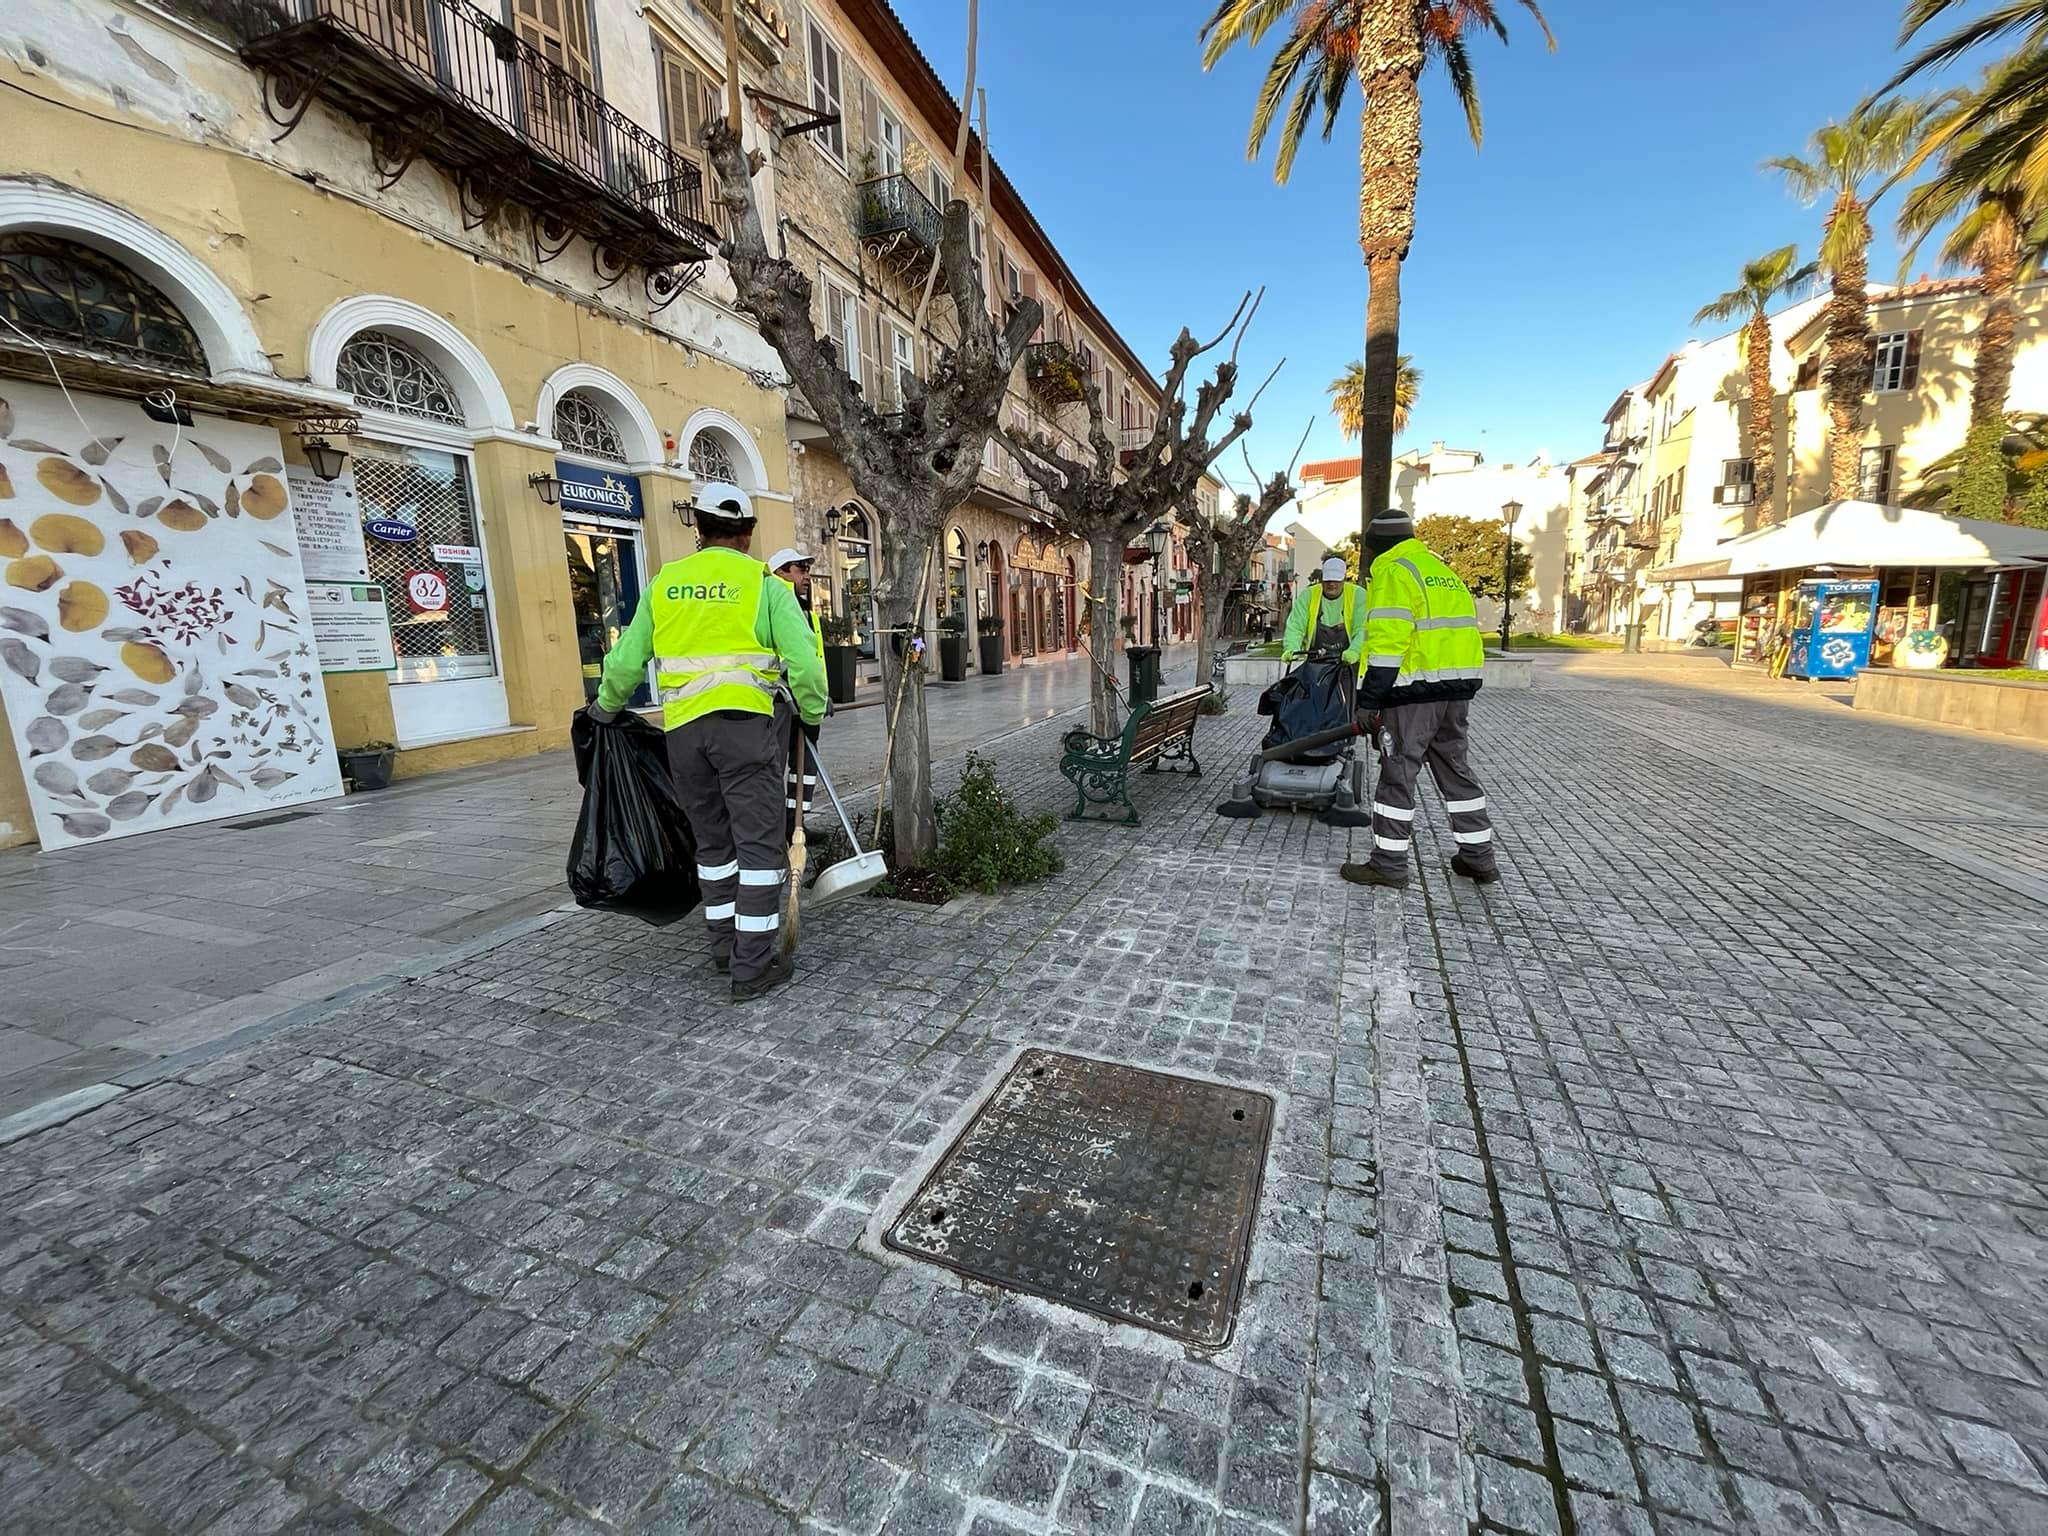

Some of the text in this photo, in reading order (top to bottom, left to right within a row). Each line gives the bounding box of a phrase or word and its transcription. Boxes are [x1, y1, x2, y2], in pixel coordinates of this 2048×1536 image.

[562, 483, 625, 505] EURONICS
[372, 522, 412, 537] Carrier
[437, 547, 471, 556] TOSHIBA
[415, 578, 441, 598] 32
[1424, 575, 1458, 588] enact
[1829, 583, 1873, 591] TOY BOX
[667, 582, 727, 600] enact
